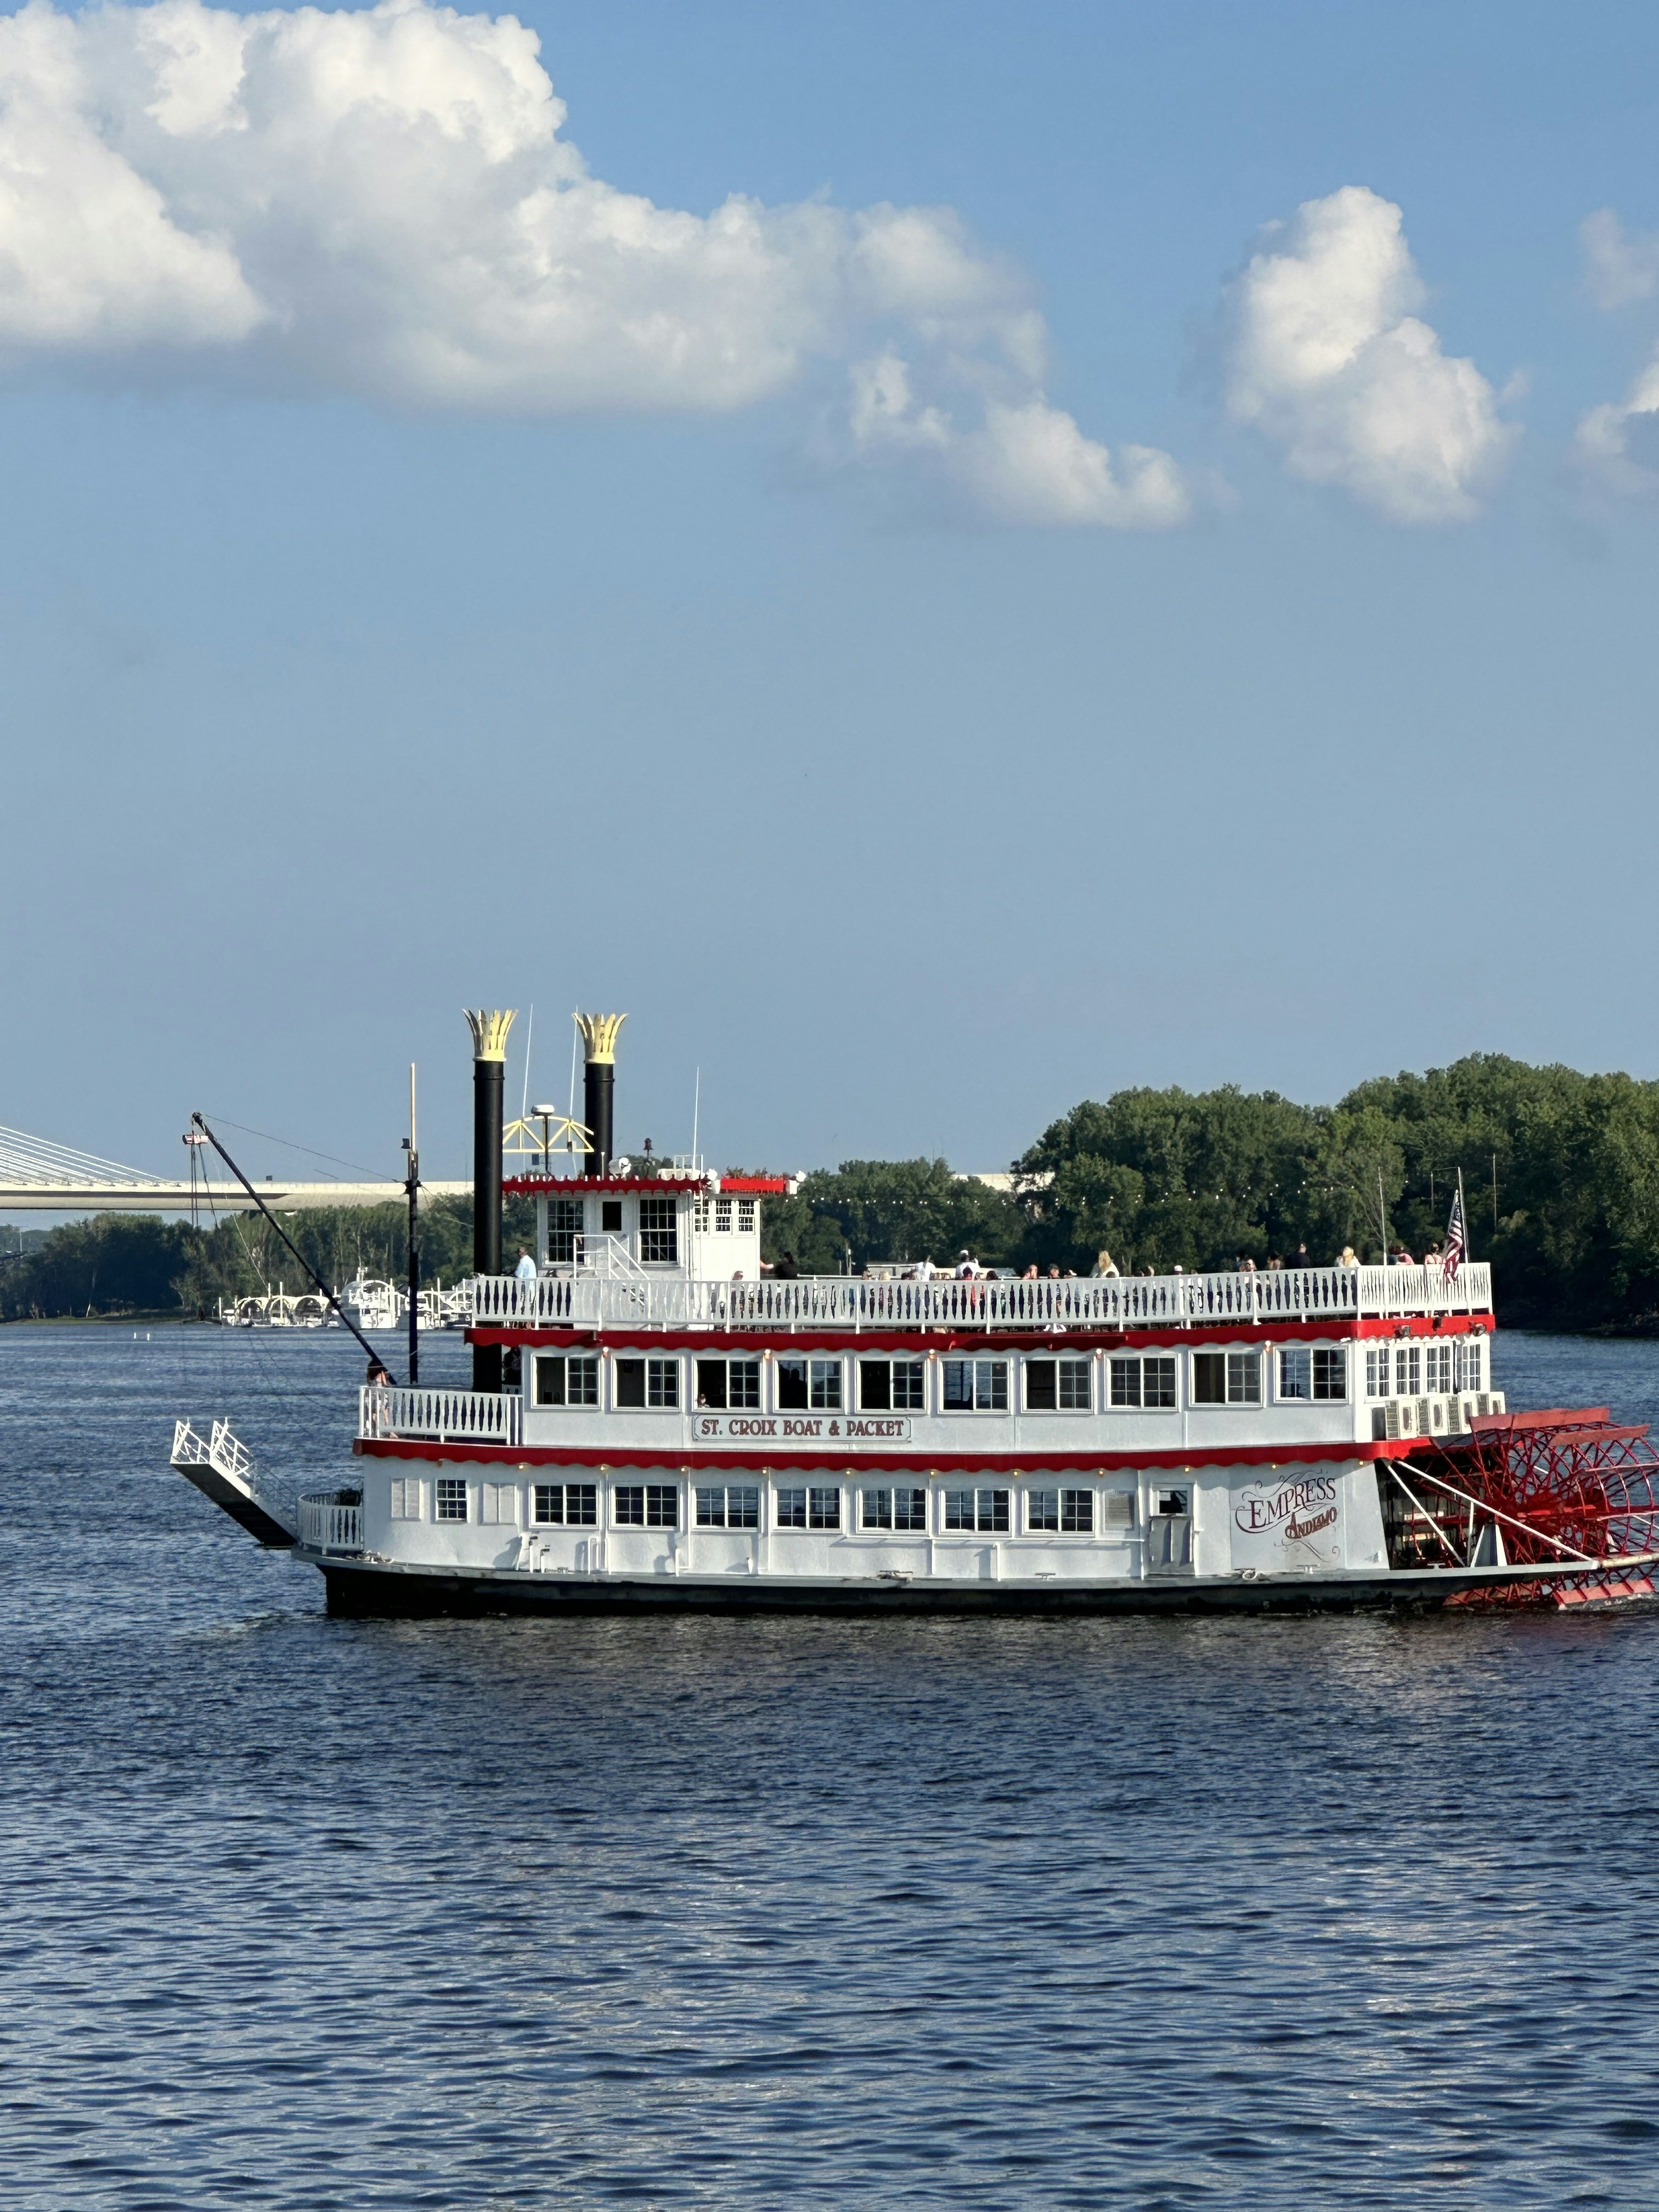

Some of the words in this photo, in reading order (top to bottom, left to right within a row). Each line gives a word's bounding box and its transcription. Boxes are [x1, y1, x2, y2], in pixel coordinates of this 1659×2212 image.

[701, 1419, 723, 1435] ST.
[729, 1419, 777, 1436] CROIX
[783, 1420, 822, 1436] BOAT
[828, 1420, 840, 1436] &
[847, 1420, 904, 1436] PACKET
[1248, 1477, 1336, 1529] EMPRESS
